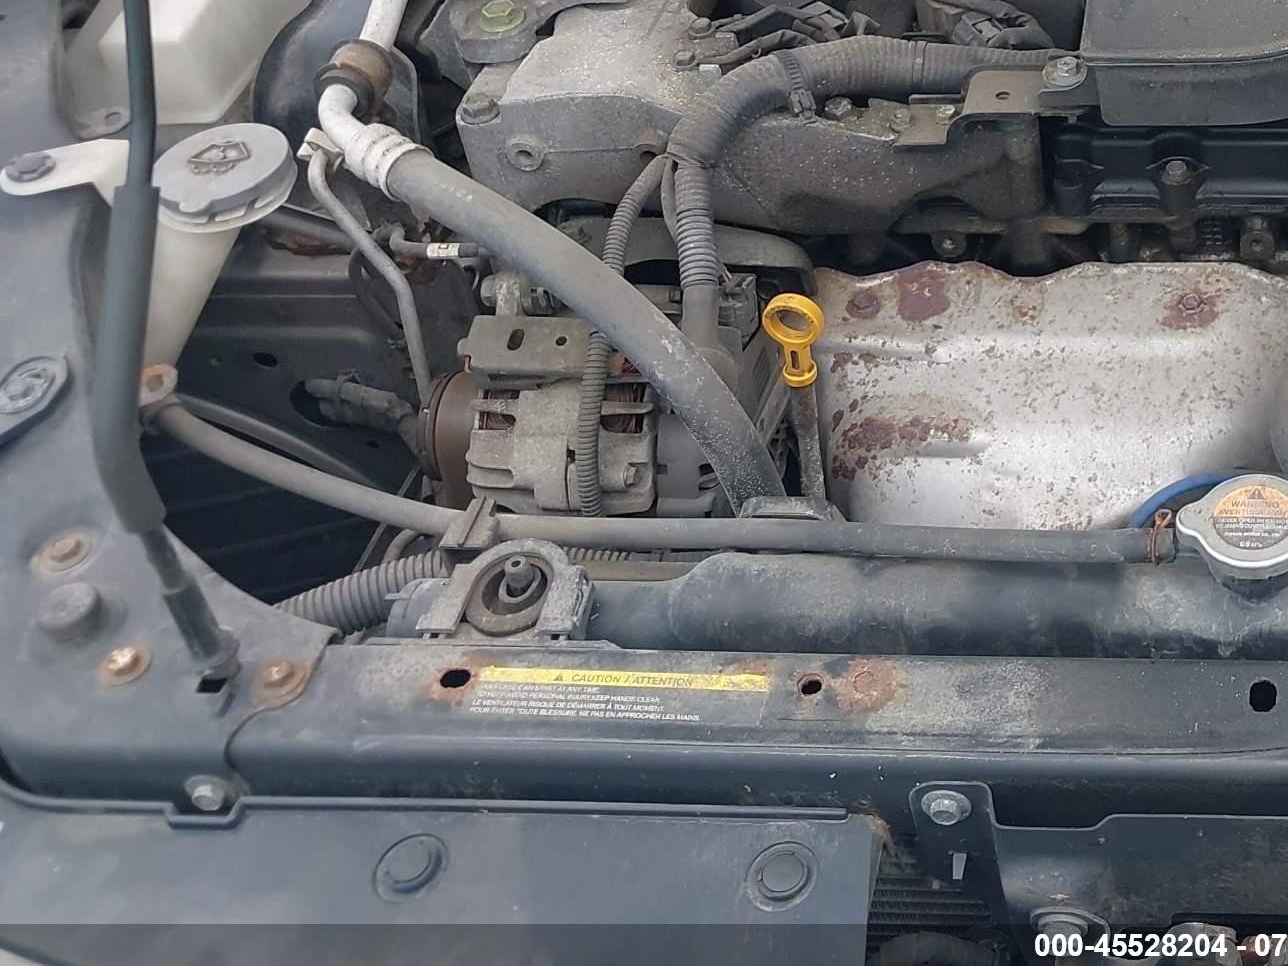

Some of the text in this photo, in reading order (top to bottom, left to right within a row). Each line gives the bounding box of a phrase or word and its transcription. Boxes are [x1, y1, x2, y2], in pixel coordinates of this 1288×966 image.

[571, 673, 621, 683] CAUTION
[631, 676, 694, 686] ATTENTION
[592, 694, 610, 702] KEEP
[611, 695, 635, 703] HANDS
[555, 700, 565, 708] DE
[613, 703, 633, 711] TOUT
[590, 710, 605, 718] PAS
